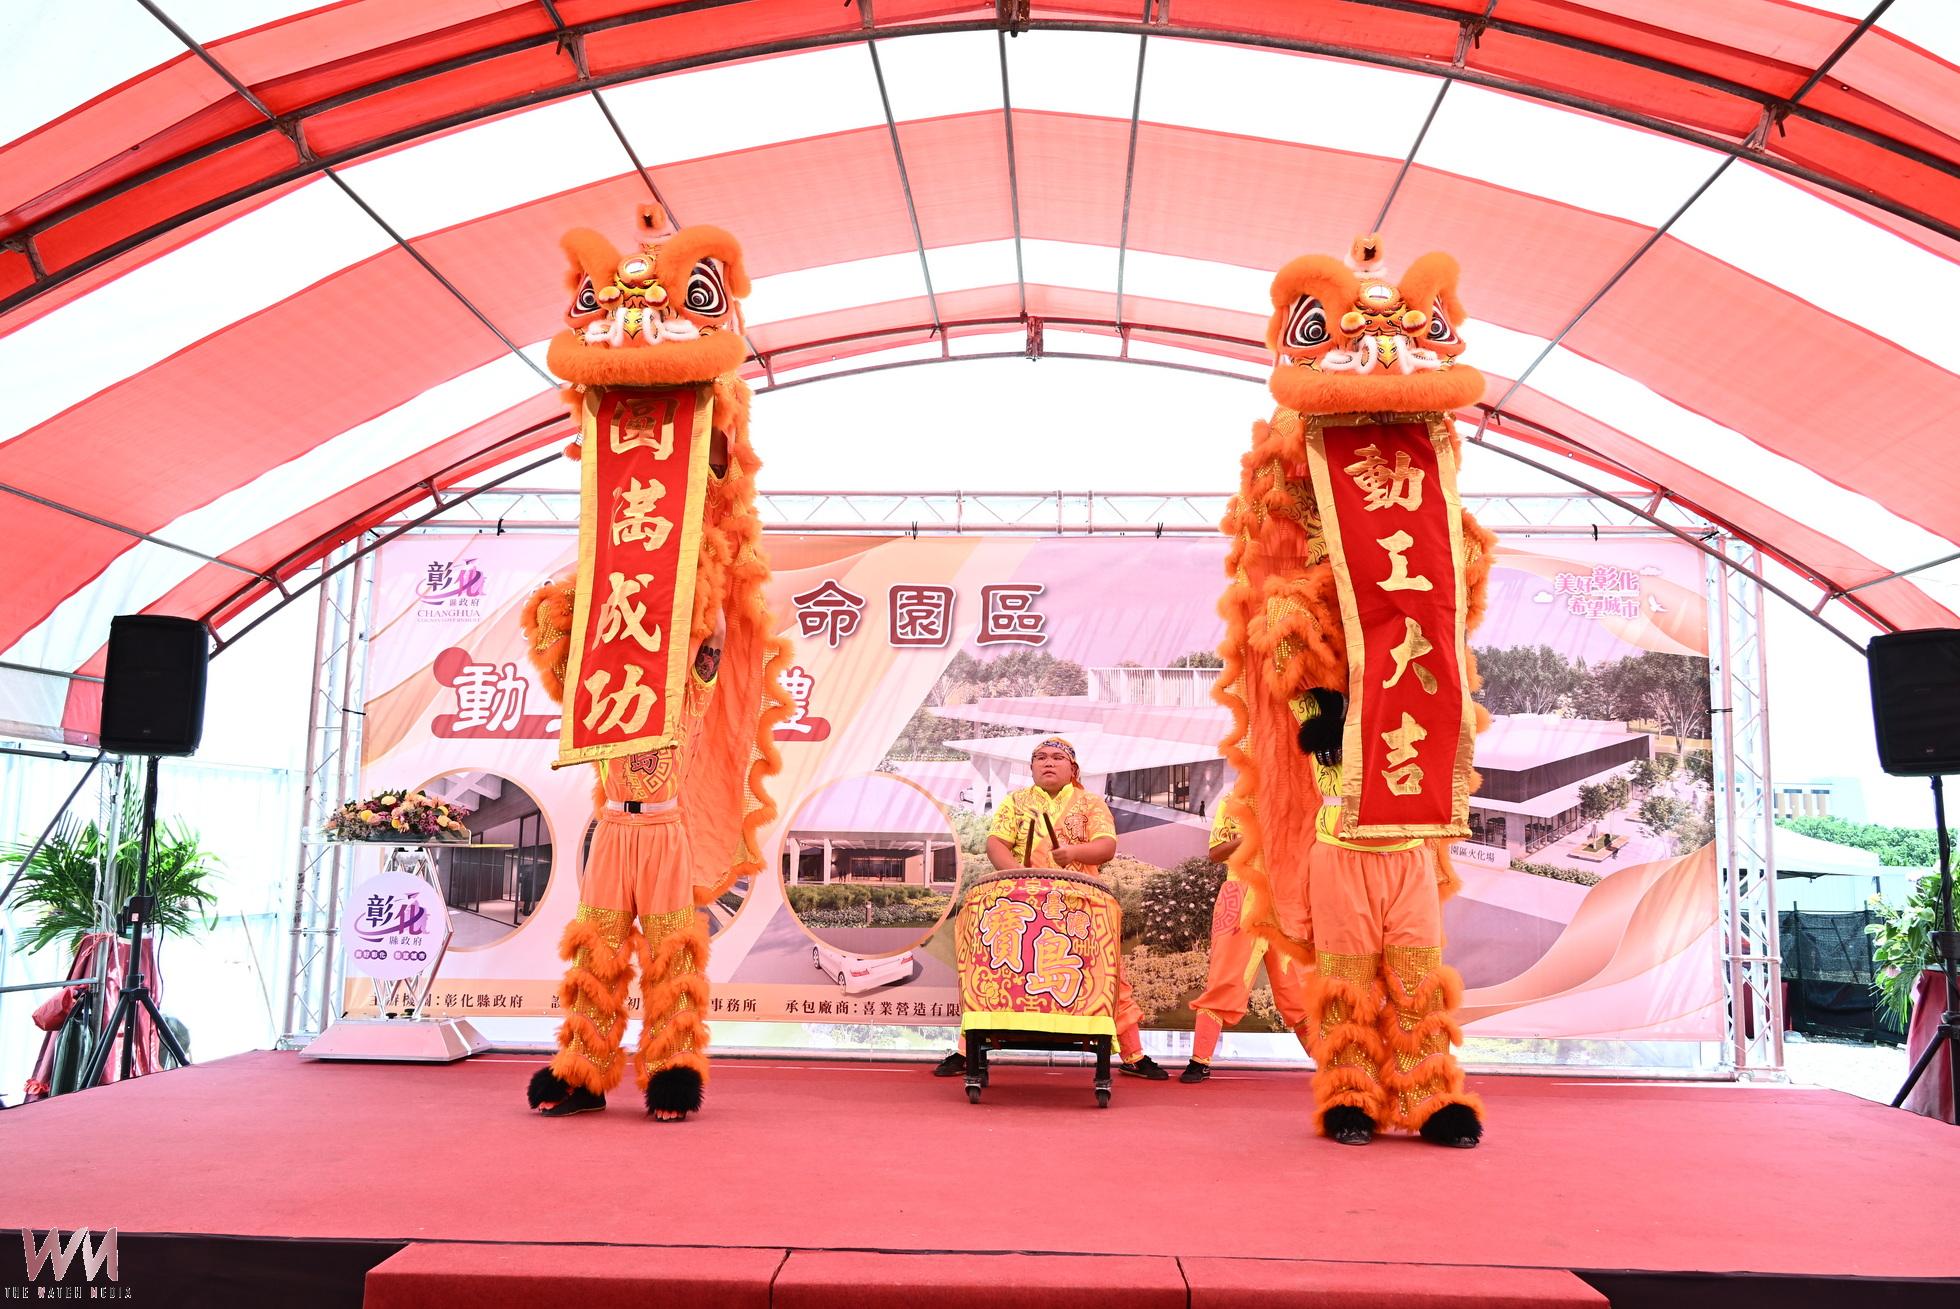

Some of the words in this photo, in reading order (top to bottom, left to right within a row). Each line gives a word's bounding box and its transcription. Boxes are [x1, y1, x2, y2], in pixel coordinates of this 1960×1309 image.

[427, 561, 482, 597] 彰化
[1556, 567, 1639, 594] 美好彰化
[418, 609, 480, 617] CHANGHUA
[792, 580, 1048, 647] 命園區
[1344, 443, 1438, 797] 動工大吉
[1570, 597, 1639, 619] 希望城市
[454, 663, 528, 732] 動
[366, 893, 425, 935] 彰化
[389, 936, 422, 946] 縣政府
[980, 898, 1084, 1007] 寶島
